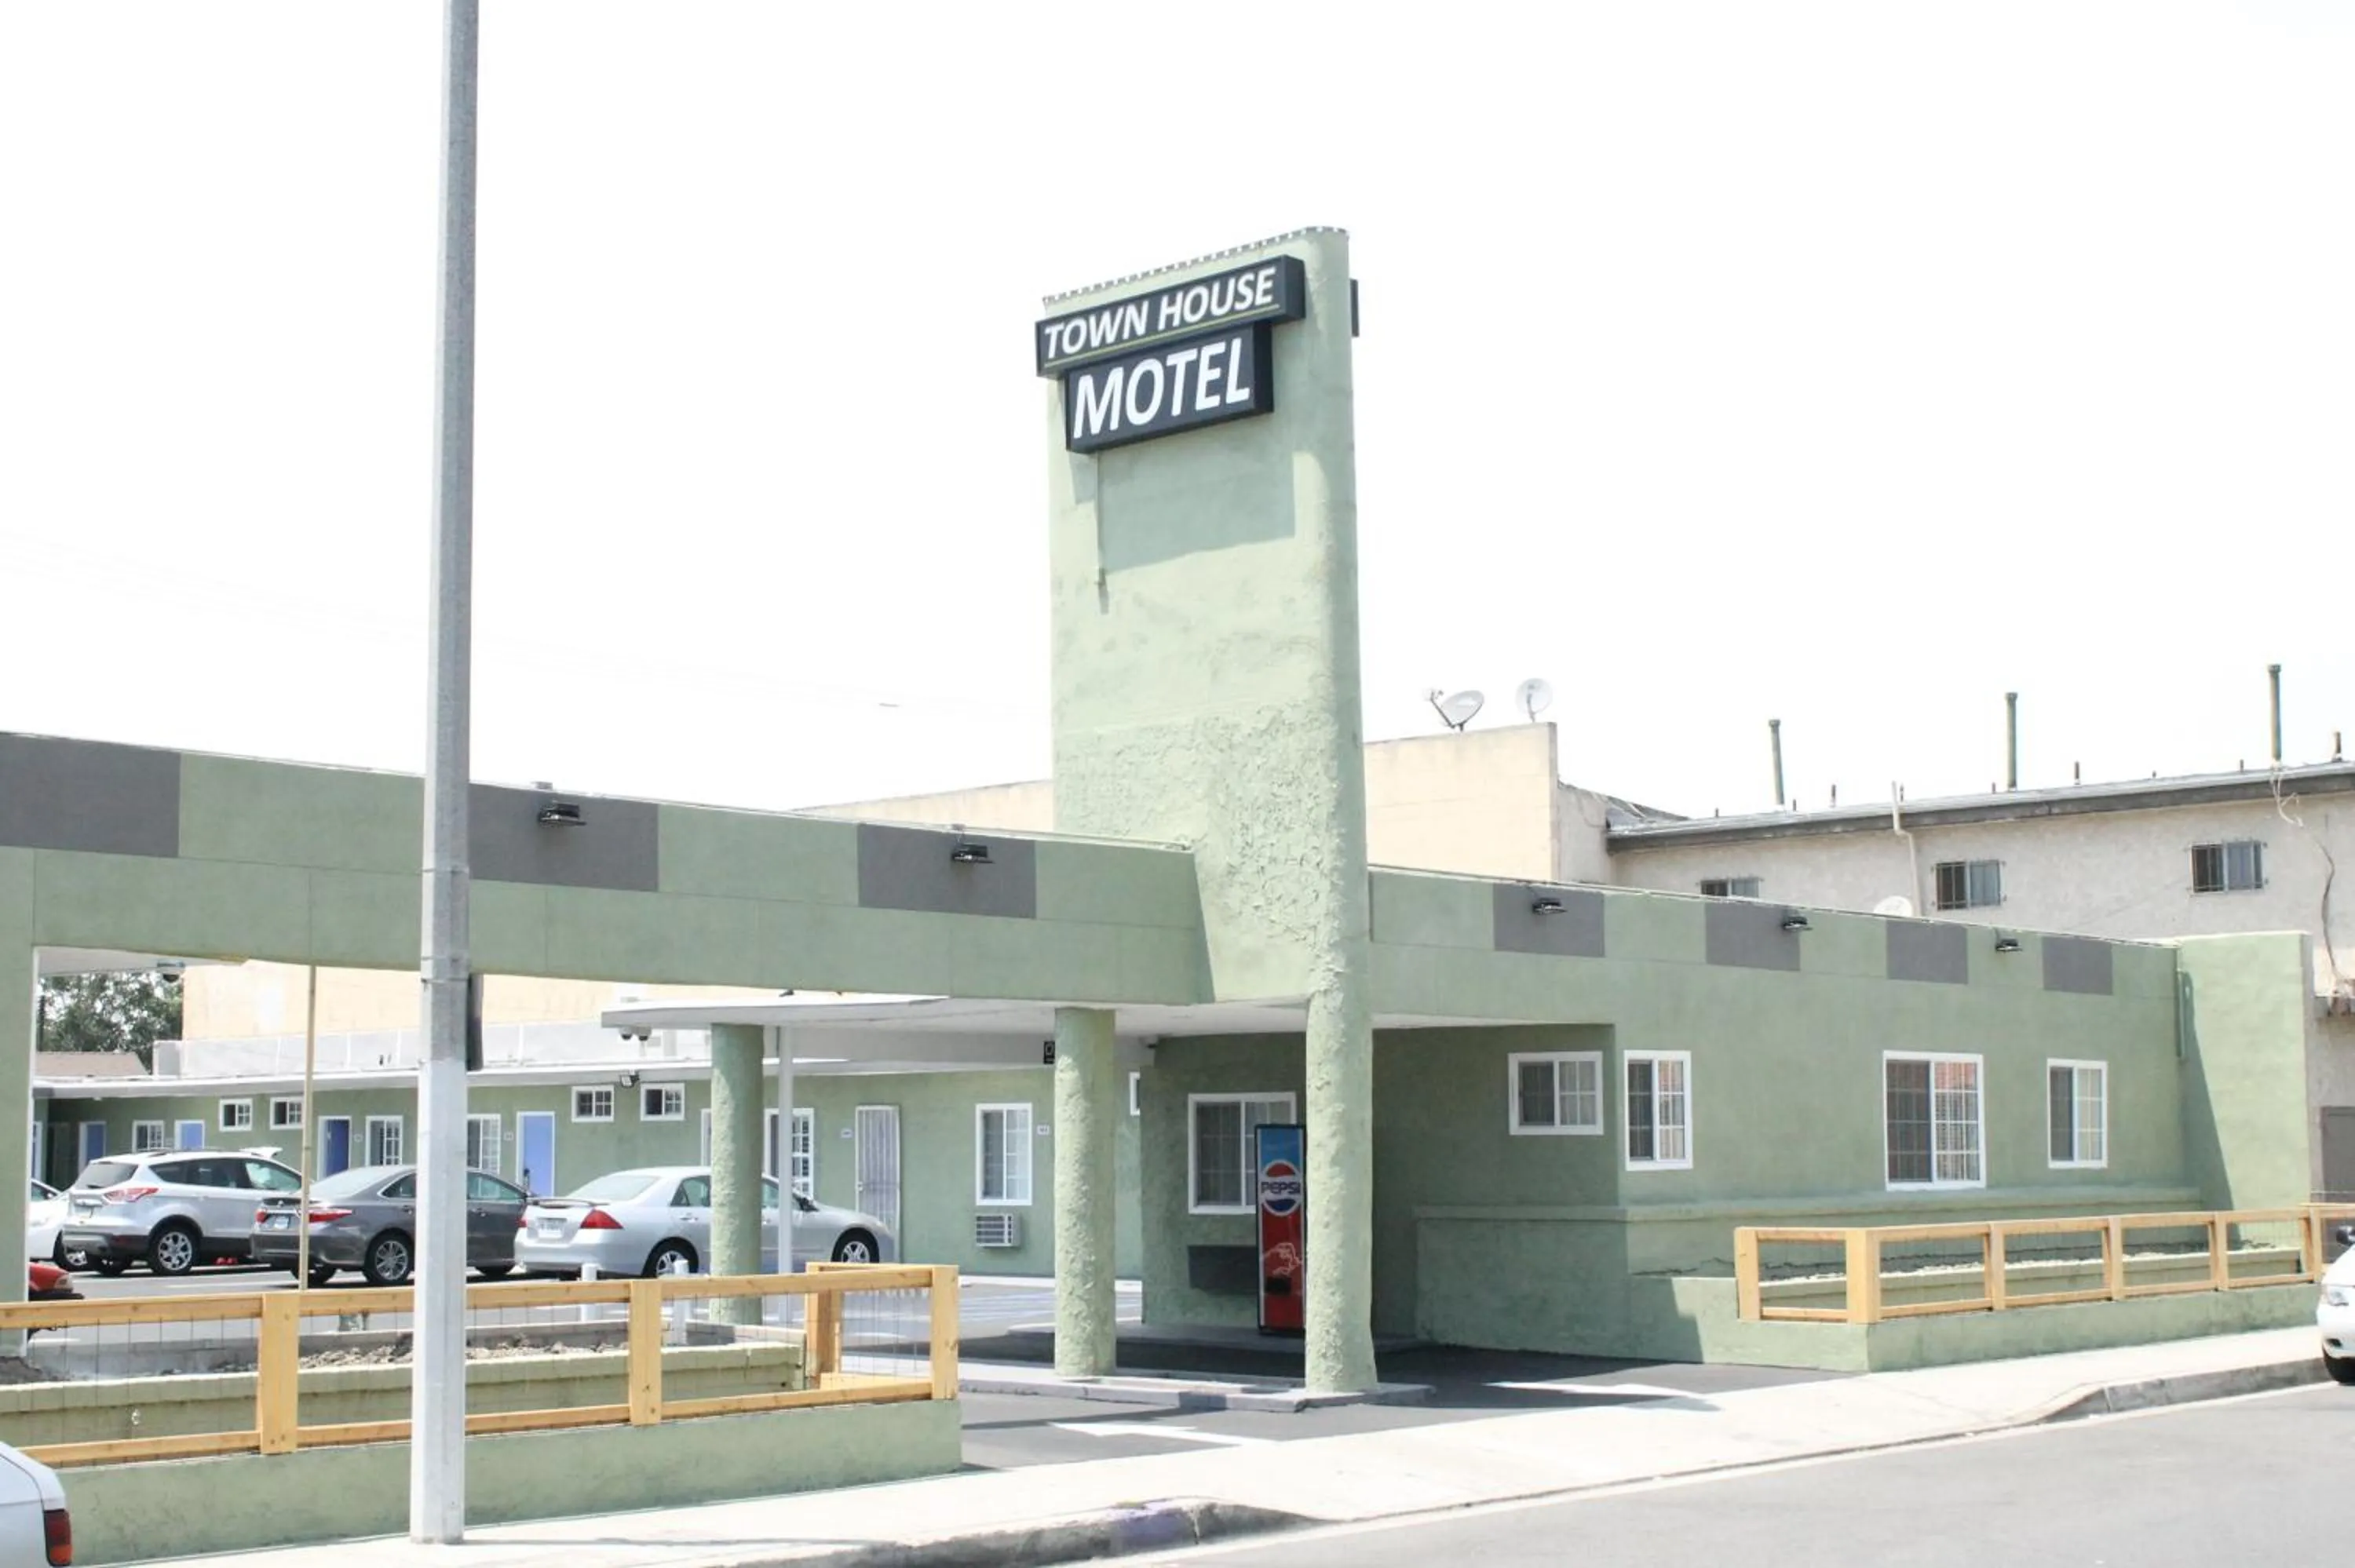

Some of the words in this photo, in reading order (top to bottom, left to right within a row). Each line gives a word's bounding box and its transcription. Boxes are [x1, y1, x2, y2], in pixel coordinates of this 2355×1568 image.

[1045, 301, 1149, 359] TOWN
[1158, 267, 1276, 330] HOUSE
[1073, 338, 1250, 439] MOTEL
[1261, 1181, 1301, 1194] PEPSI
